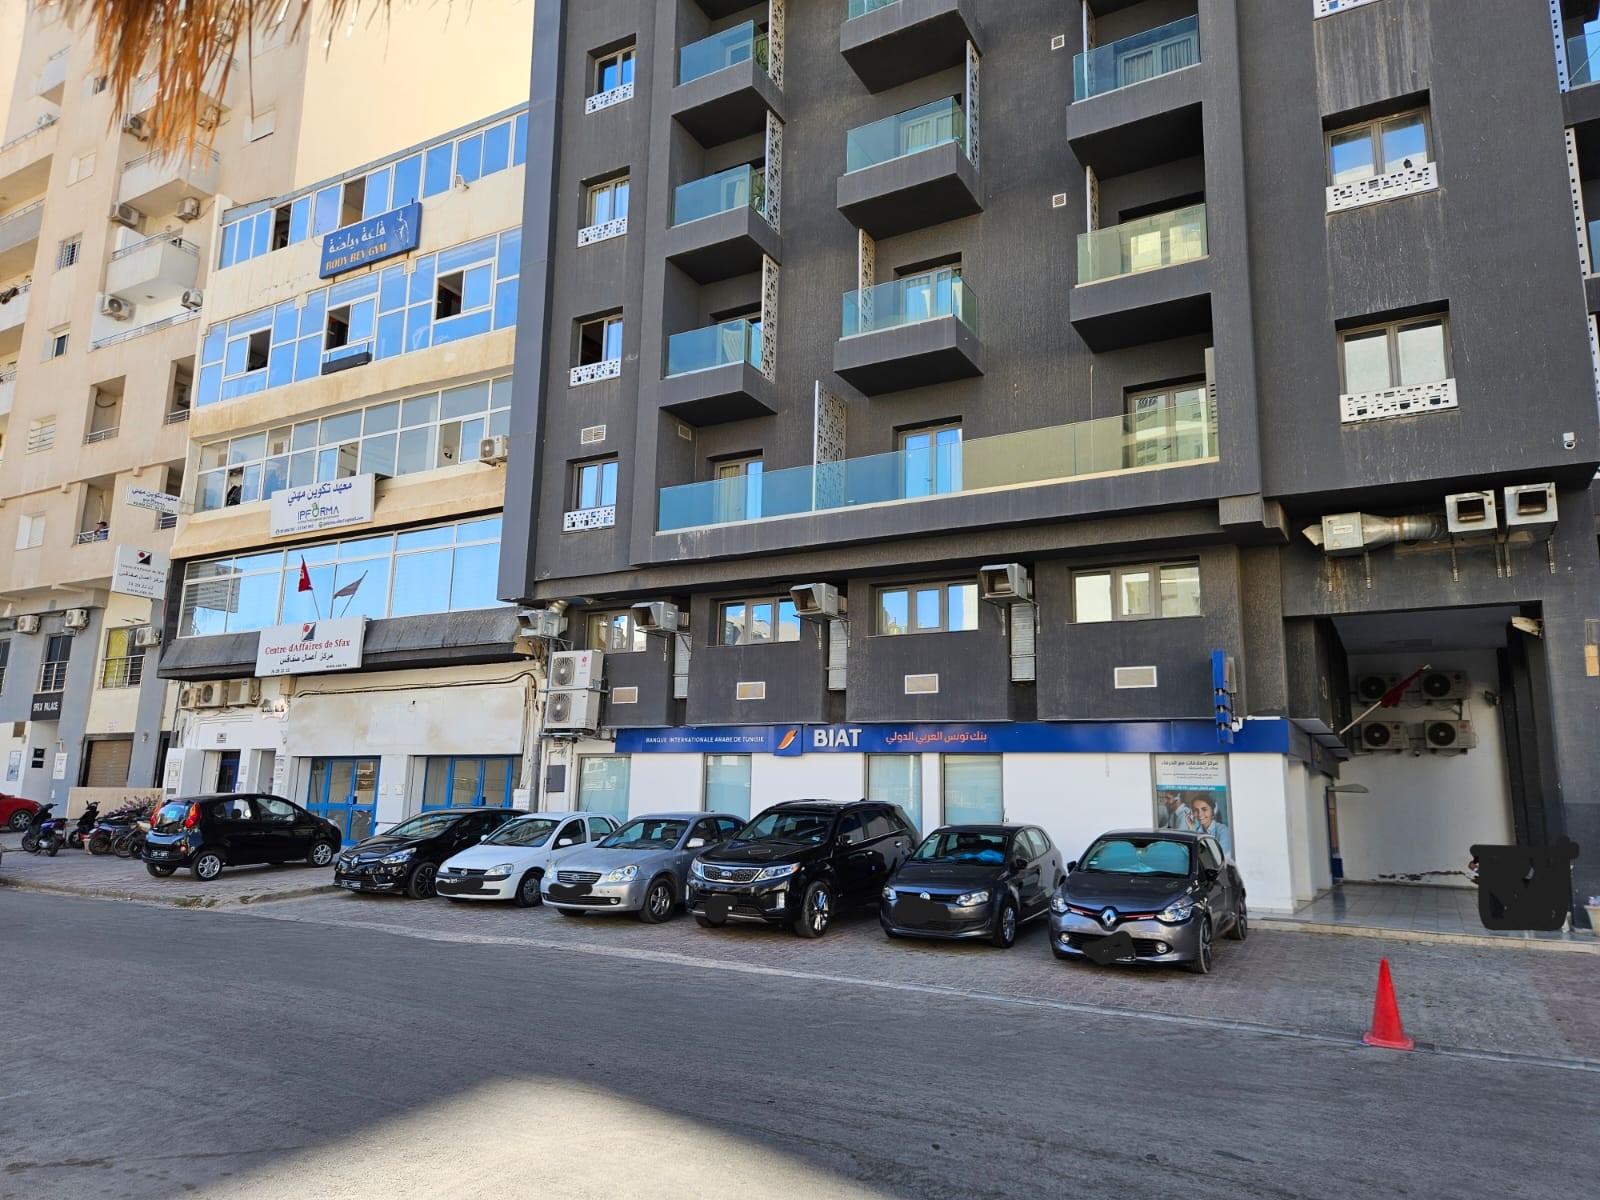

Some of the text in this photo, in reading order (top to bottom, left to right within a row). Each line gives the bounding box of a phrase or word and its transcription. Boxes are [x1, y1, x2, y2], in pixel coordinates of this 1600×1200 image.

[329, 220, 386, 253] قاعة رياضة
[287, 481, 352, 506] معهد تكوين مهني
[265, 645, 287, 655] Centre
[325, 640, 333, 648] de
[334, 639, 351, 647] Sfax
[280, 654, 300, 665] صفاقس
[320, 652, 333, 661] مركز
[669, 736, 714, 744] INTERNATIONALE
[813, 728, 862, 747] BIAT
[885, 731, 987, 744] بنك تونس العربي الدولي
